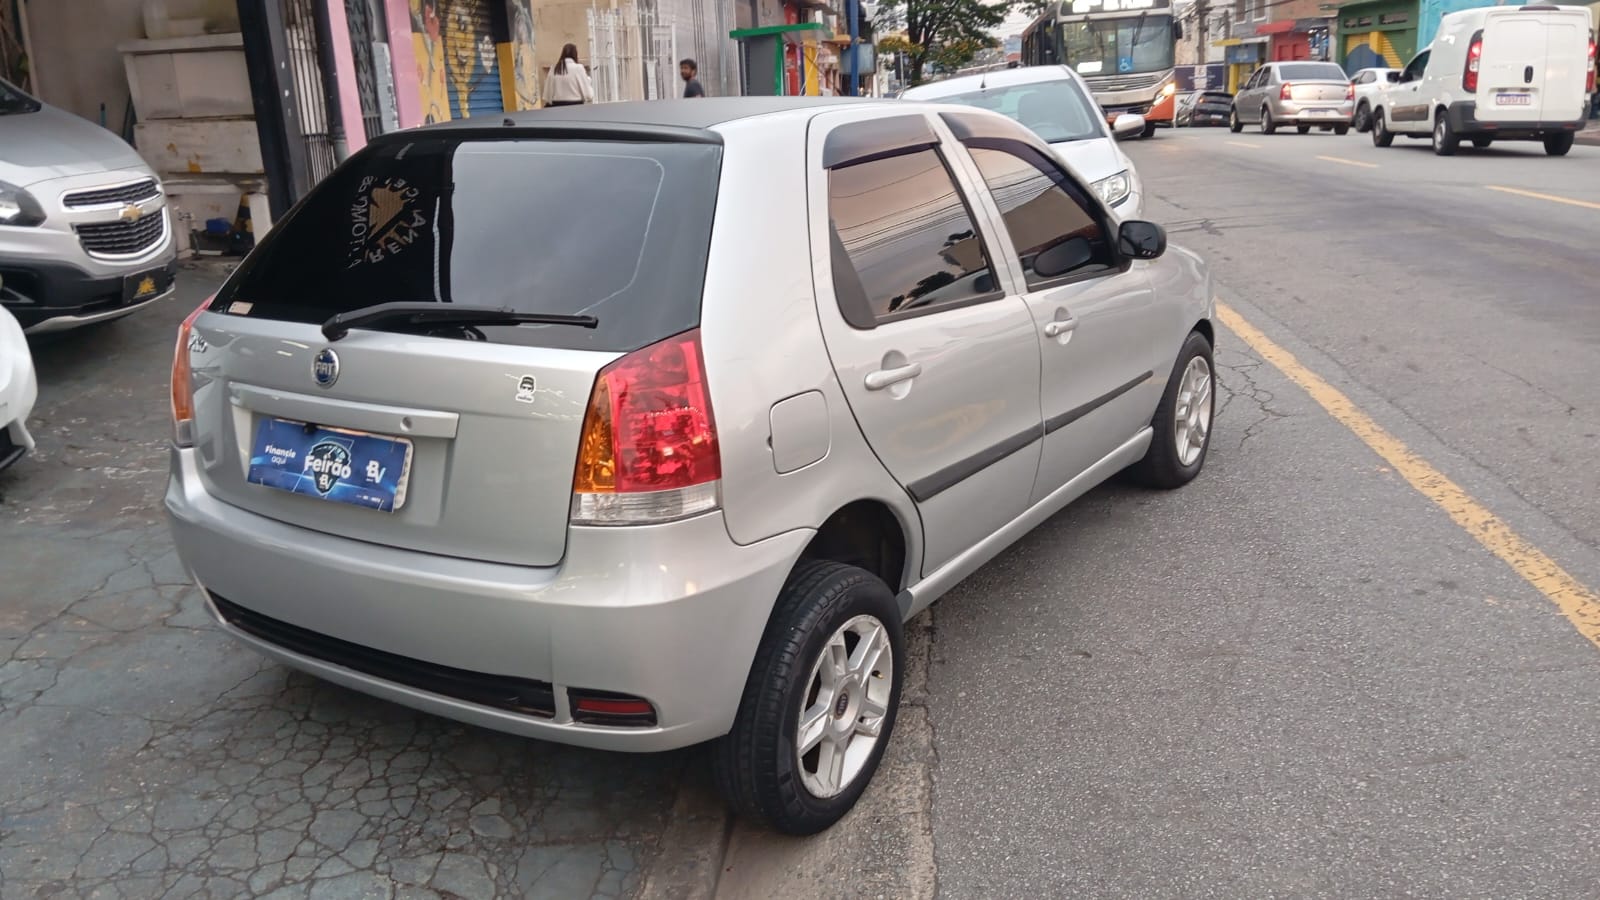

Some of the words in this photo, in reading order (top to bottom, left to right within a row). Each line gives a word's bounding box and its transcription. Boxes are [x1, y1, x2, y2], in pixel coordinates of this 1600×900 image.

[315, 362, 338, 377] FIAT
[265, 444, 297, 458] Financie
[271, 455, 288, 466] aqui
[304, 452, 352, 479] Feirão
[366, 460, 386, 483] BV
